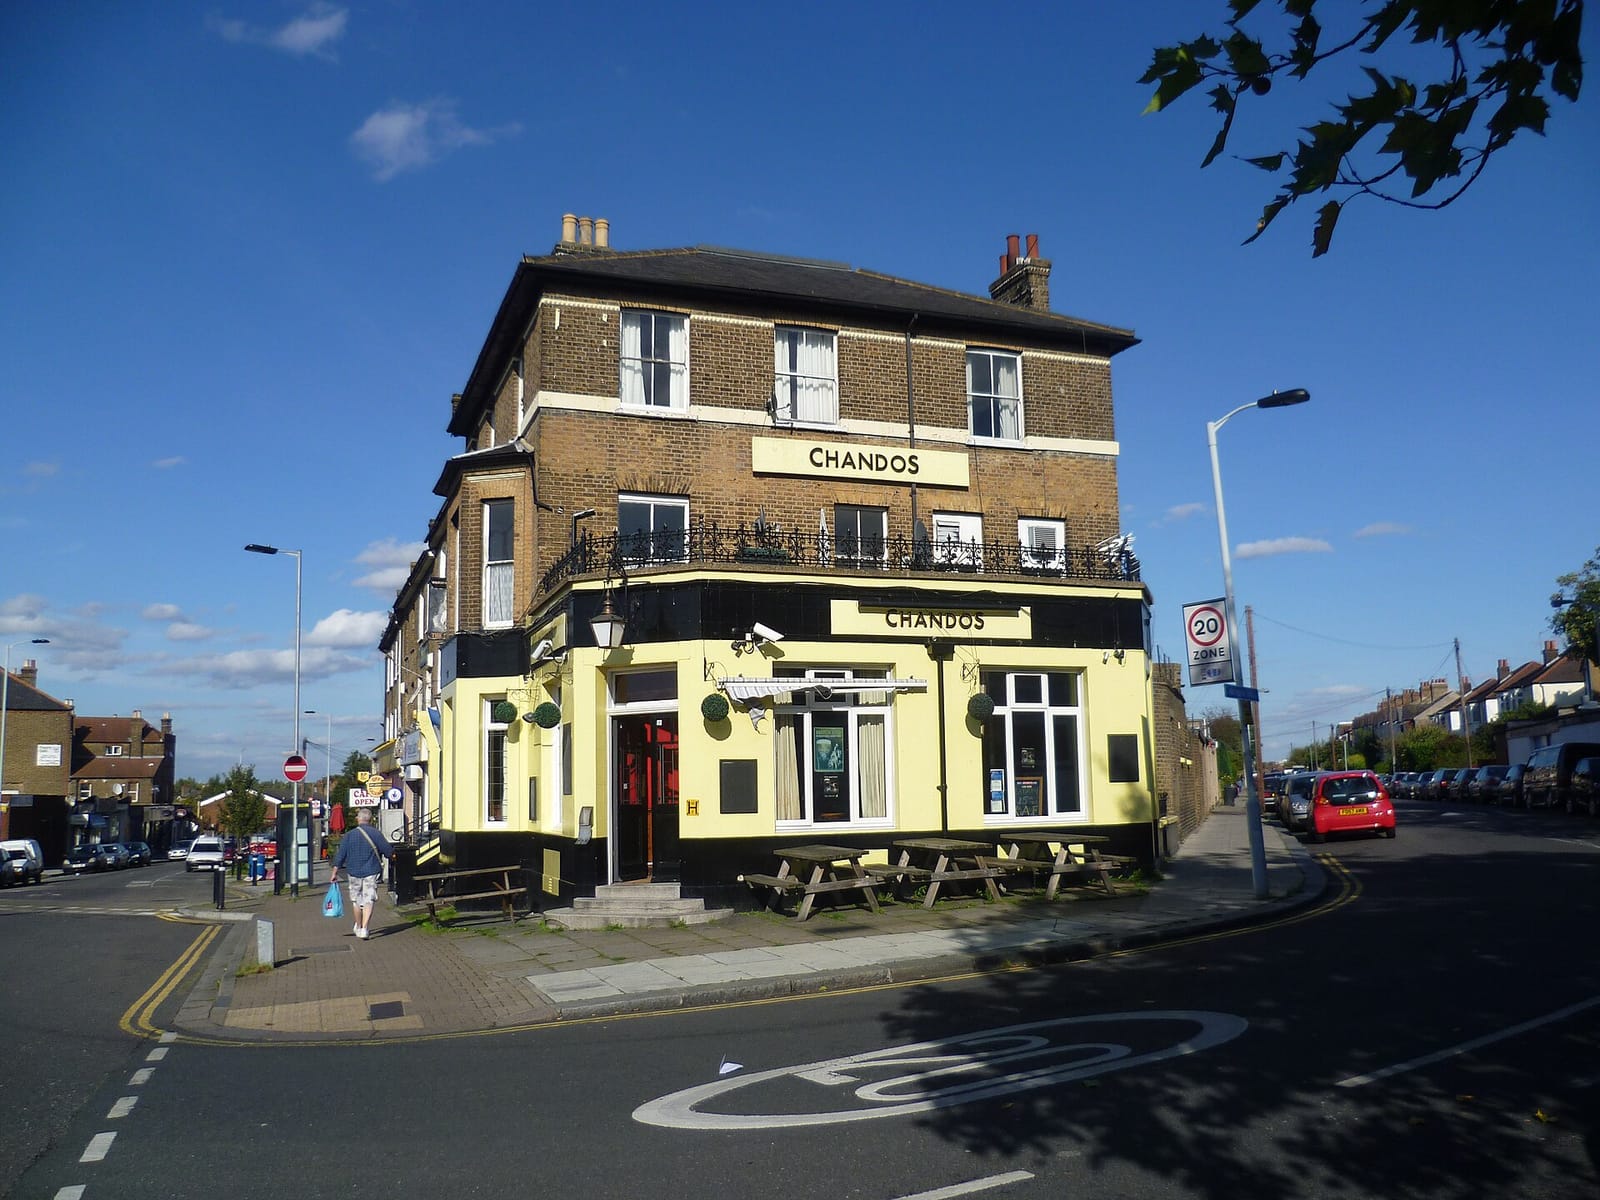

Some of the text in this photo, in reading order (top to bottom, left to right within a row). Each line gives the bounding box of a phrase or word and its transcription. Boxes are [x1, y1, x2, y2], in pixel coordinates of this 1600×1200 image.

[809, 447, 919, 475] CHANDOS
[886, 608, 984, 630] CHANDOS
[1194, 618, 1218, 635] 20
[1193, 647, 1225, 660] ZONE
[687, 800, 698, 815] H
